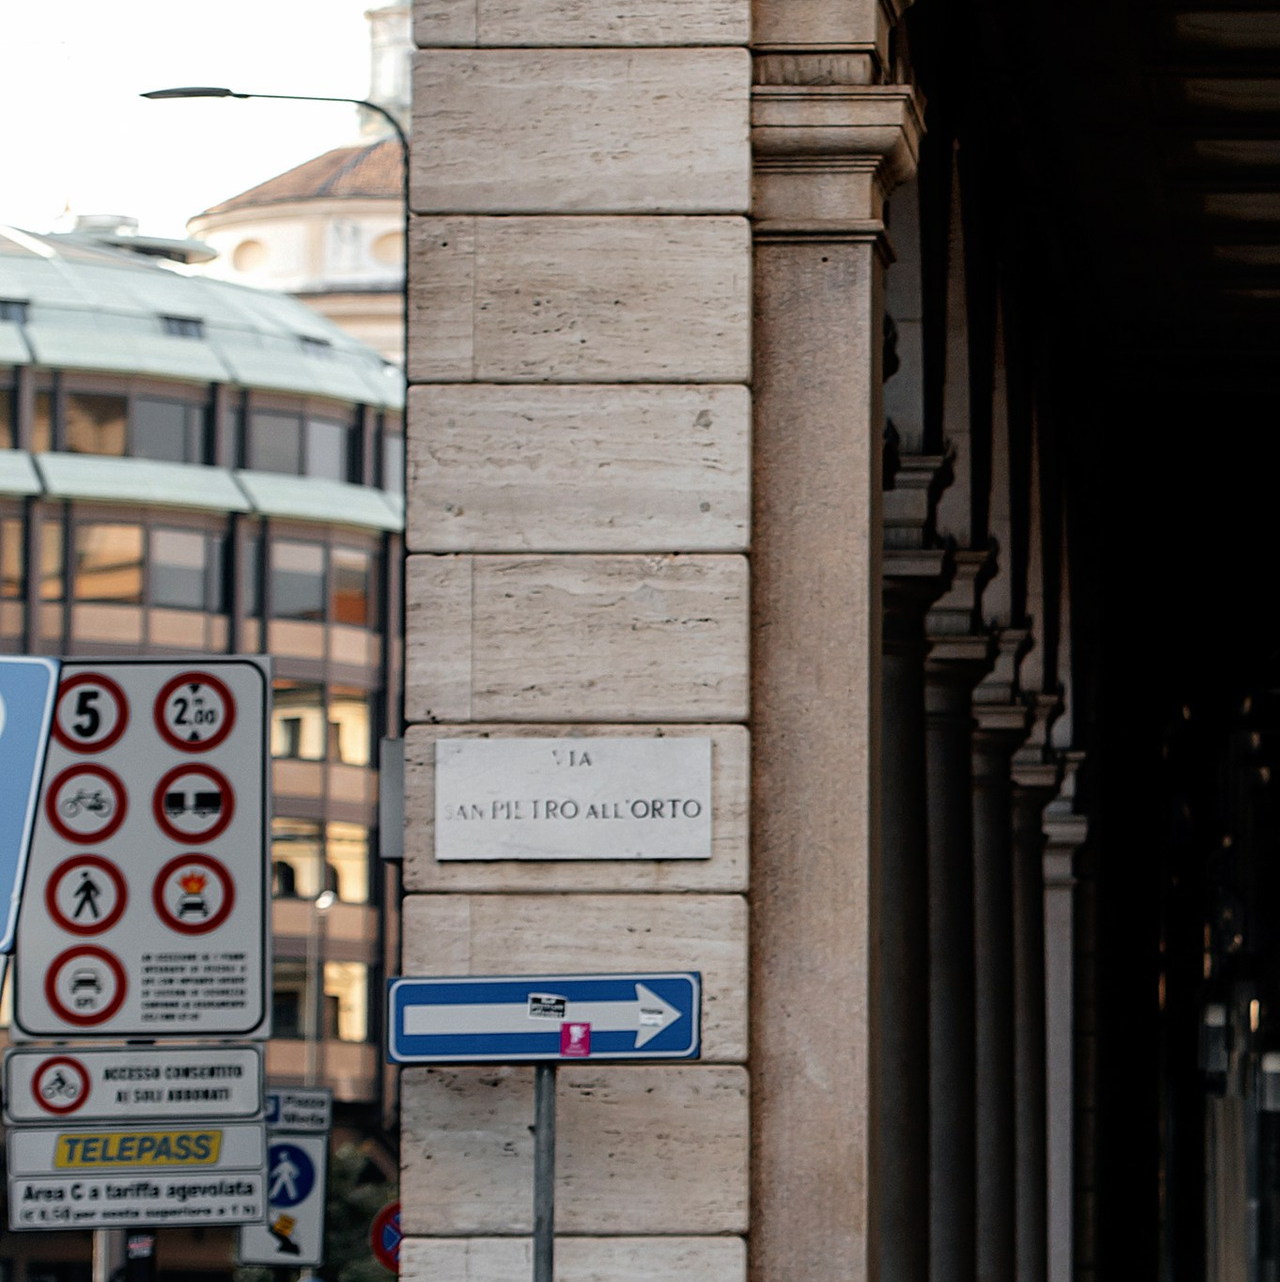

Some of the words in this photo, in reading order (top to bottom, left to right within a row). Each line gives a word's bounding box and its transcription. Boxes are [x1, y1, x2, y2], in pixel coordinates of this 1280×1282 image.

[73, 691, 100, 738] 5
[552, 750, 592, 767] VIA
[491, 800, 579, 819] PIETRO
[586, 799, 701, 819] ALL'ORTO
[103, 1067, 160, 1081] ACCESSO
[165, 1065, 243, 1079] CONSENTITO
[64, 1134, 212, 1164] TELEPASS
[23, 1185, 64, 1201] Area
[70, 1184, 83, 1200] C
[88, 1188, 98, 1199] a
[105, 1183, 159, 1199] tariffa
[166, 1180, 253, 1202] agevolata
